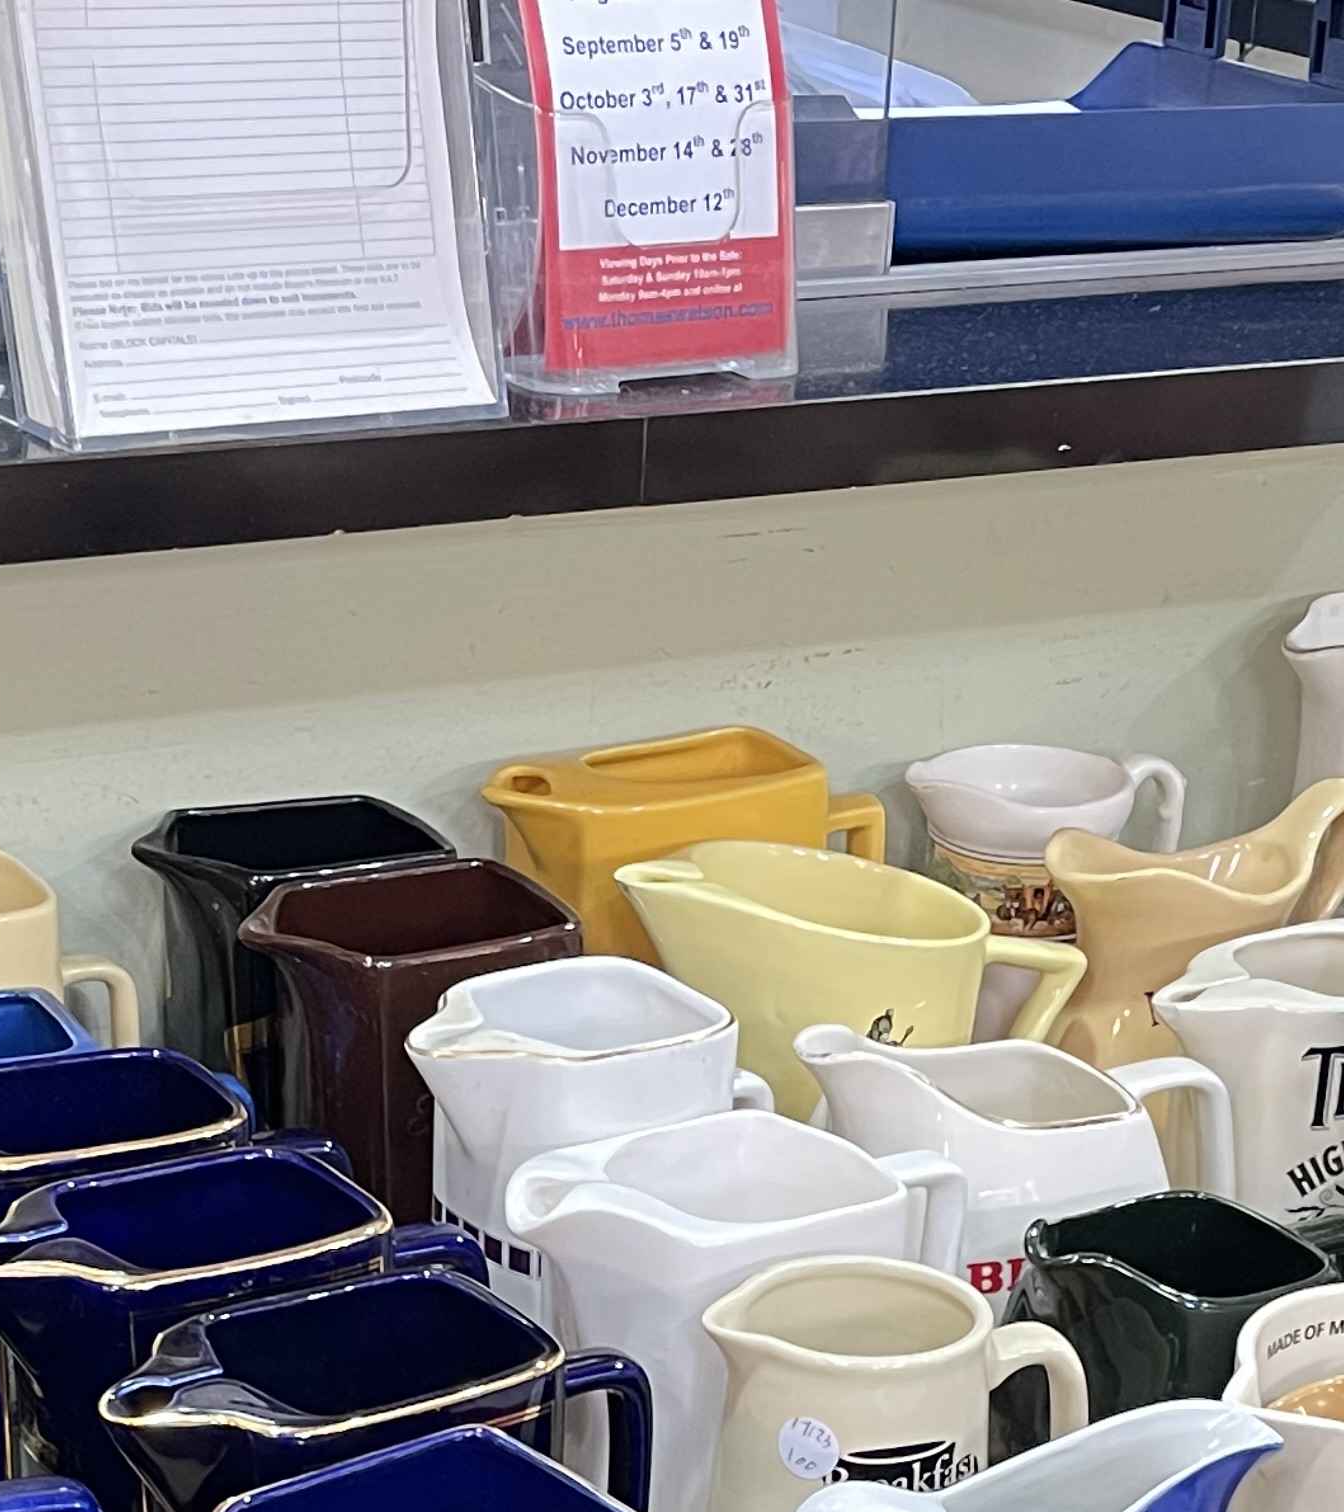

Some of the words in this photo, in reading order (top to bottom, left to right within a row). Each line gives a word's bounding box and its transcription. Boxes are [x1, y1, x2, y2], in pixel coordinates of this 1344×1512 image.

[562, 35, 664, 59] September
[670, 27, 692, 52] 5th
[699, 32, 713, 51] &
[719, 25, 750, 49] 19th
[560, 87, 636, 112] October
[676, 80, 710, 106] 17th
[715, 84, 729, 102] &
[733, 78, 766, 103] 31st
[570, 143, 667, 167] November
[673, 134, 705, 160] 14th
[711, 138, 725, 157] &
[604, 195, 697, 218] December
[703, 188, 735, 213] 12th
[1304, 1321, 1325, 1340] OF
